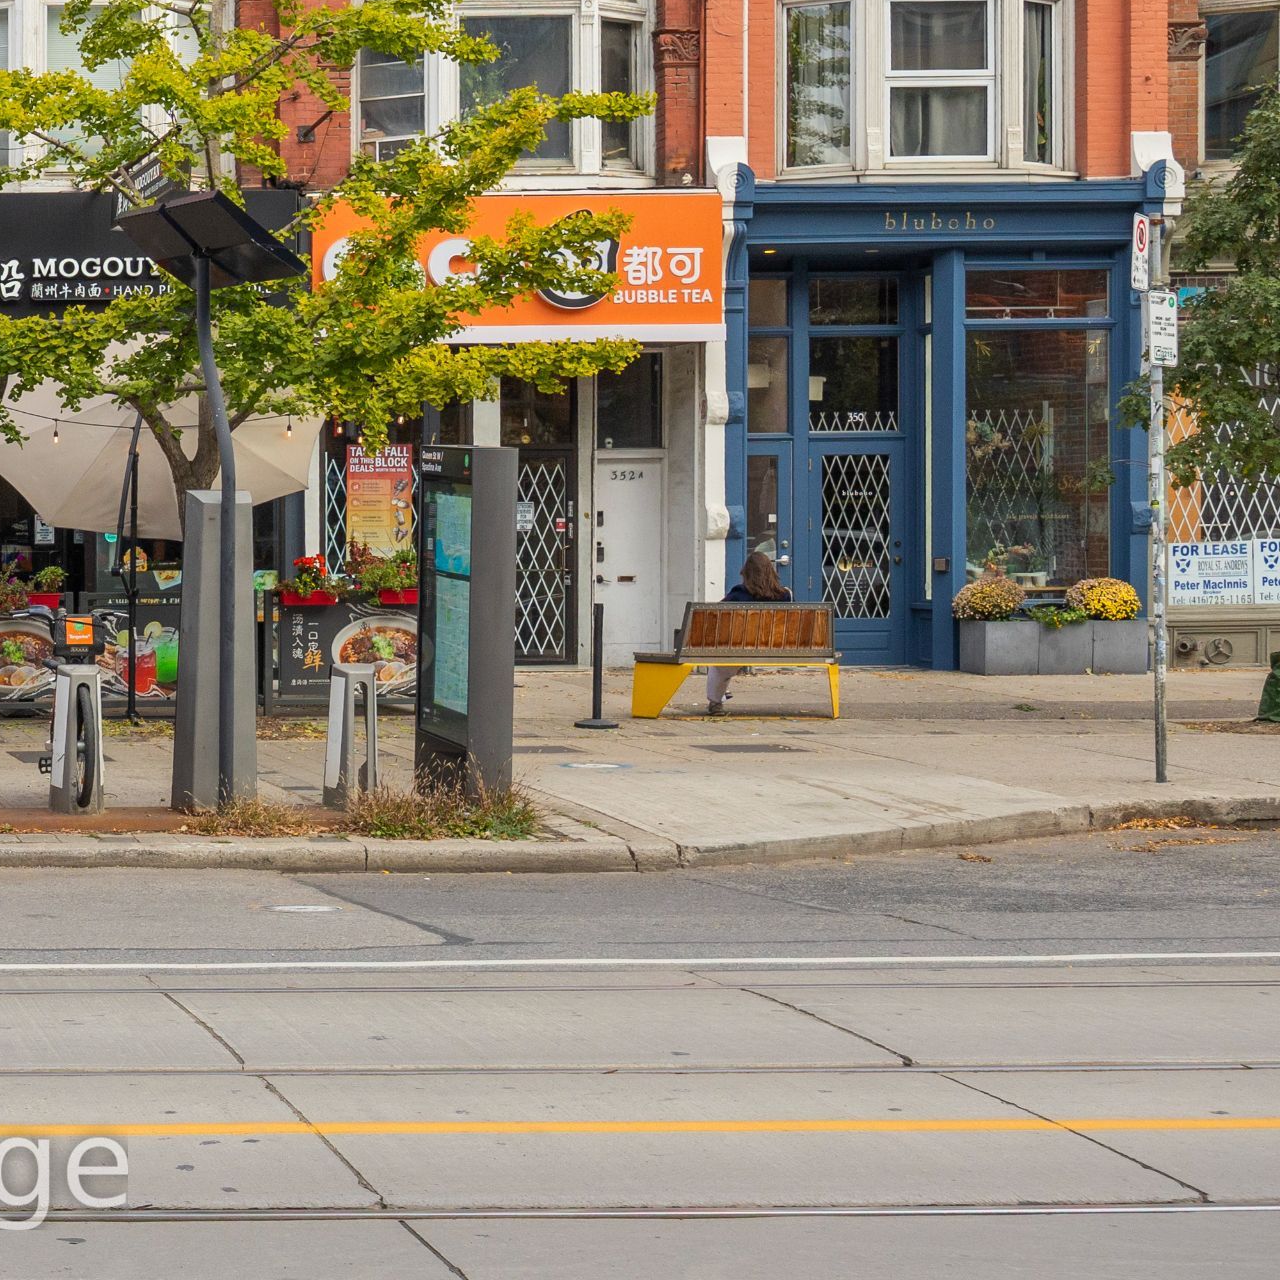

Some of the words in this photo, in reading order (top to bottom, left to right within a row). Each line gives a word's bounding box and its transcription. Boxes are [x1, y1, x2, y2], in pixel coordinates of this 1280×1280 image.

[1007, 184, 1053, 214] 88
[885, 211, 995, 230] bluboho
[32, 256, 161, 278] MOGOUY
[622, 245, 704, 286] 都可
[612, 288, 678, 305] BUBBLE
[684, 288, 714, 304] TEA
[384, 446, 409, 457] FALL
[350, 464, 375, 472] DEALS
[375, 457, 408, 467] BLOCK
[1172, 545, 1199, 557] FOR
[1203, 543, 1248, 556] LEASE
[1260, 541, 1280, 553] FO
[1174, 580, 1200, 590] Peter
[1202, 578, 1248, 590] MacInnis
[1172, 596, 1186, 605] Tel:
[1259, 592, 1274, 601] Tel:
